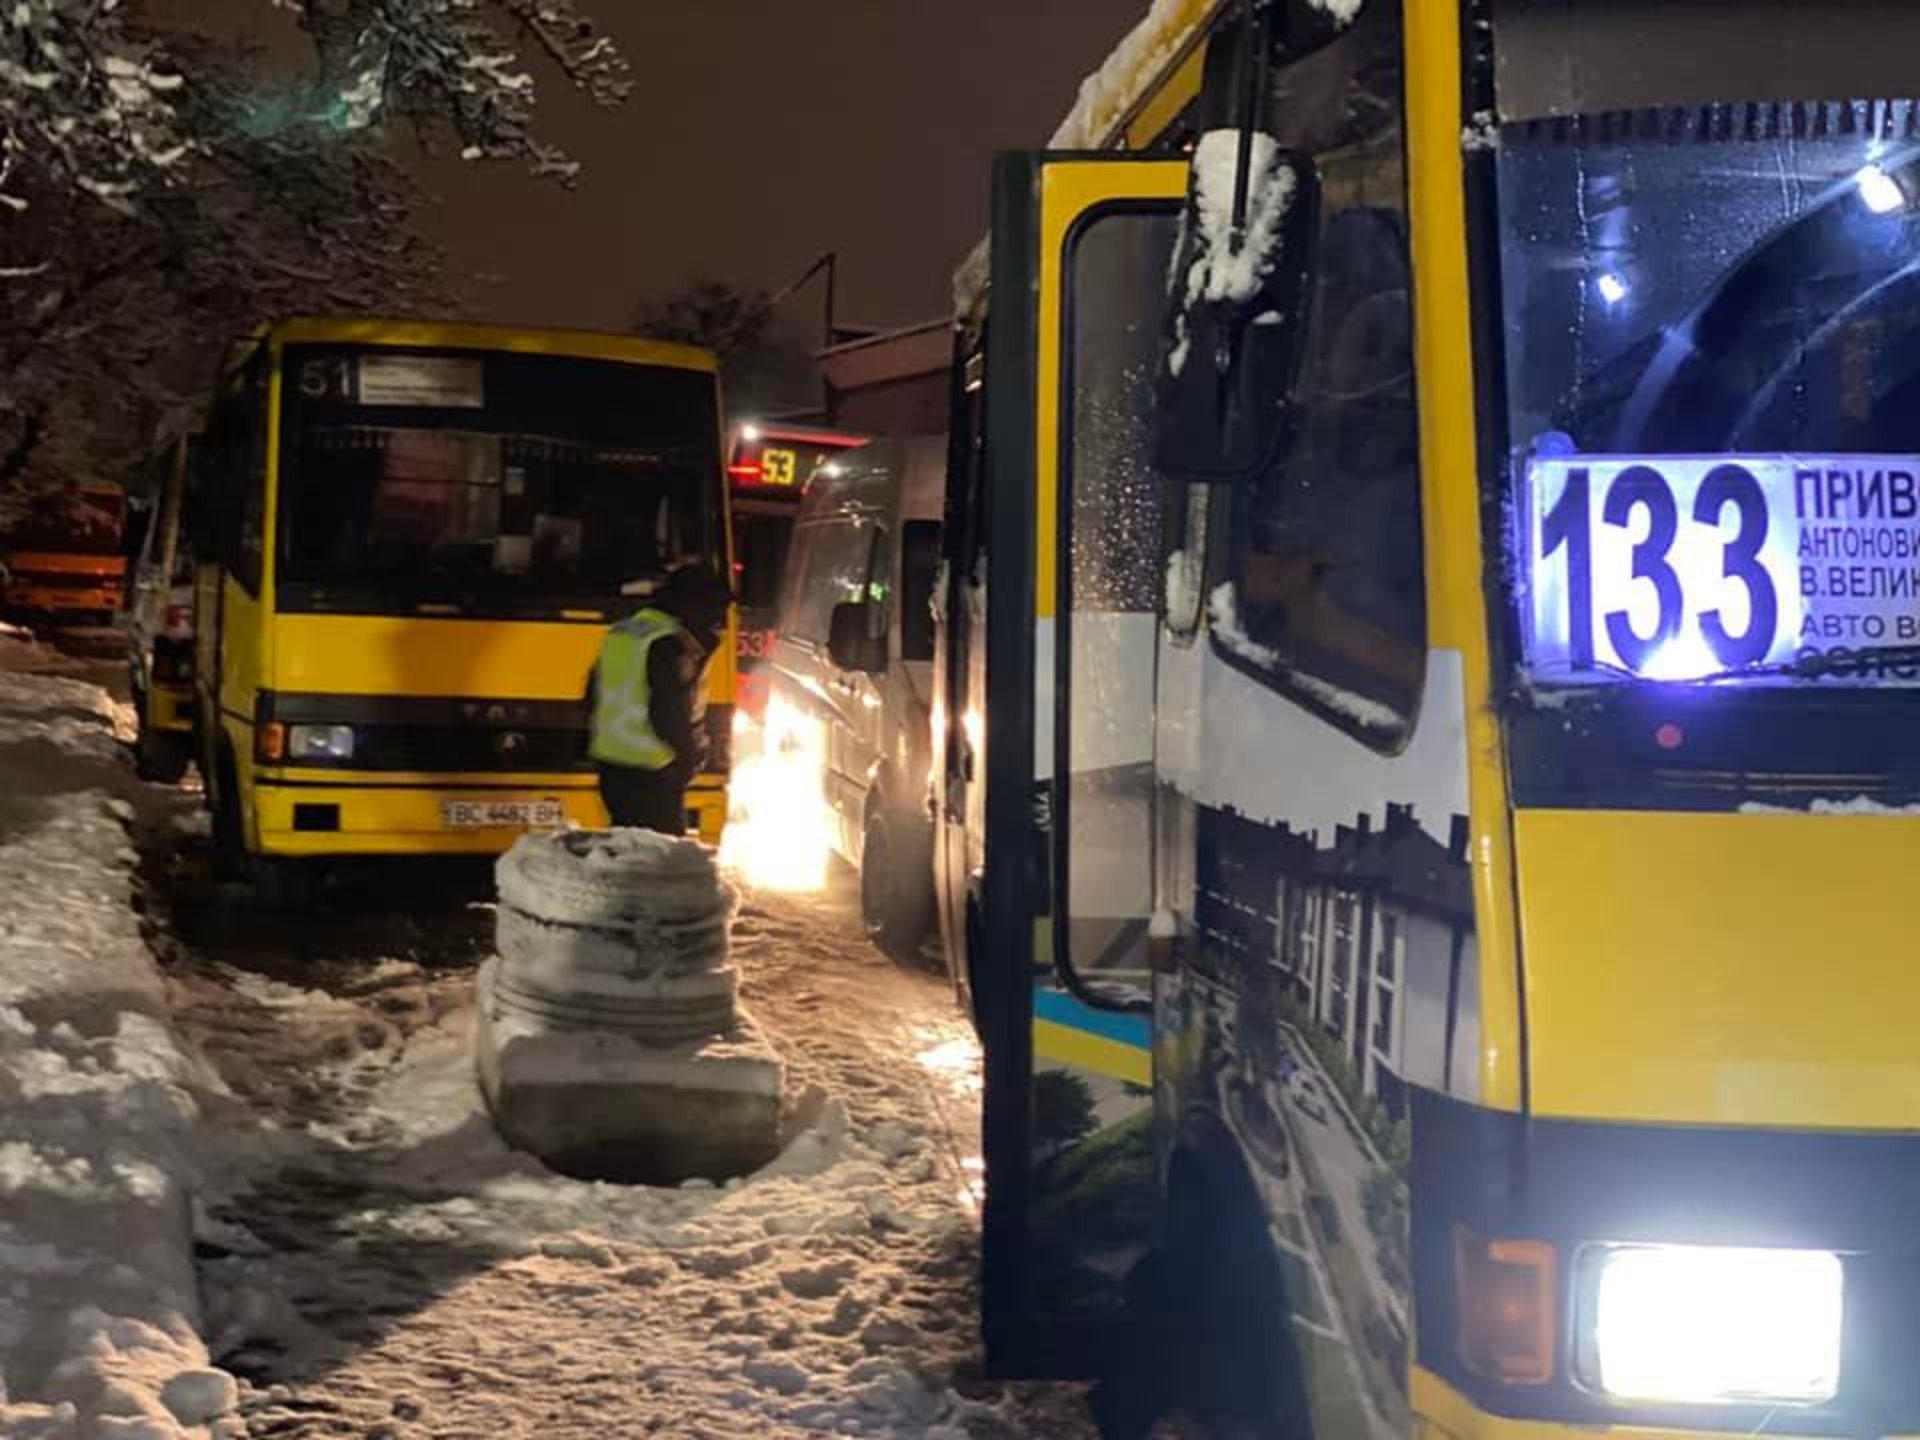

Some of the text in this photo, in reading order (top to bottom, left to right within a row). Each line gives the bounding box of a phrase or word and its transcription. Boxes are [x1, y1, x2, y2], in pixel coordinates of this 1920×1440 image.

[762, 449, 796, 485] 53
[1793, 470, 1920, 519] ПРИВ
[1541, 463, 1778, 673] 133
[1799, 614, 1920, 639] АВТО В
